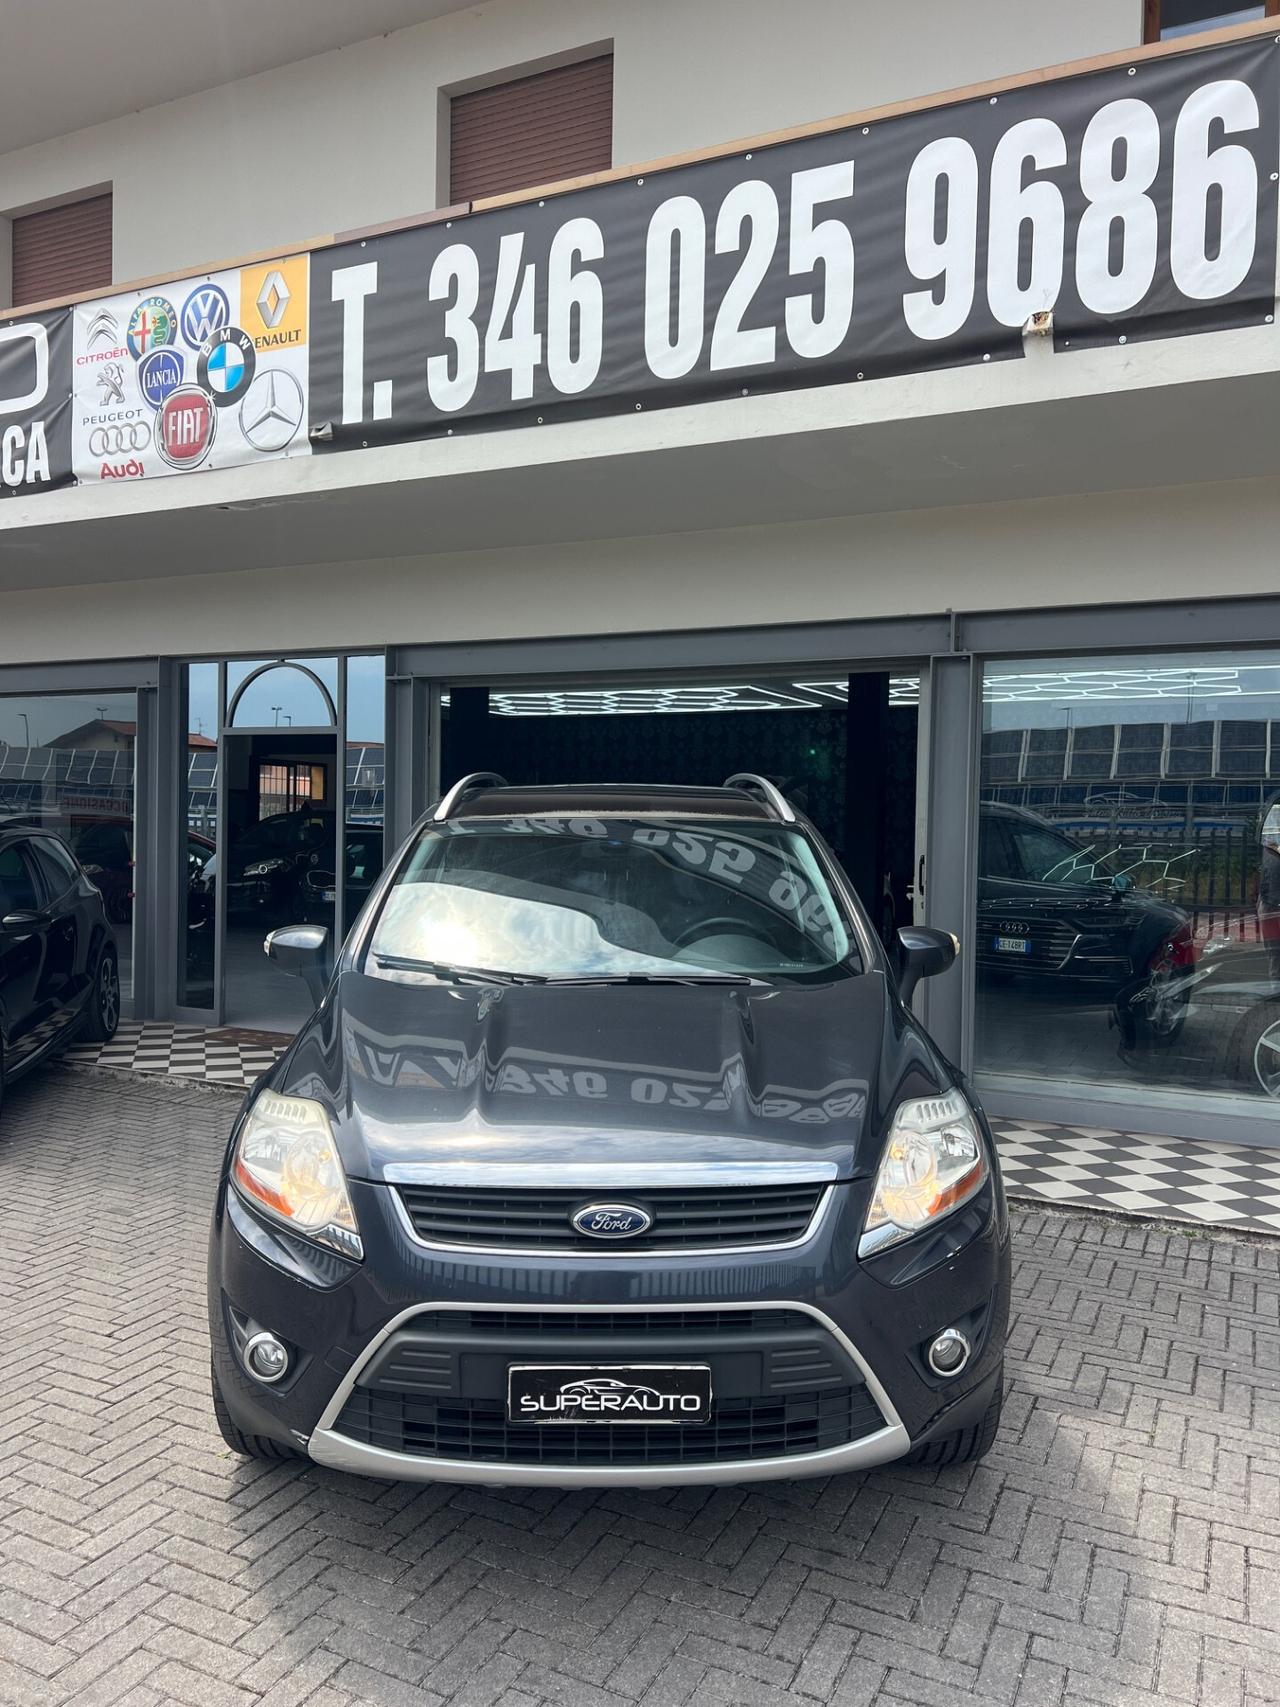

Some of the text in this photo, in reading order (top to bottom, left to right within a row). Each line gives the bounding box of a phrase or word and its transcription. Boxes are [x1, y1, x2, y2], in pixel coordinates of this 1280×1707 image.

[331, 79, 1260, 425] T. 346 025 9686
[127, 298, 177, 336] ALFA ROMEO
[201, 328, 251, 357] BMW
[253, 329, 301, 348] ENAULT
[146, 368, 177, 389] LANCIA
[82, 408, 144, 426] PEUGEOT
[167, 406, 205, 447] FIAT
[100, 458, 145, 479] Audi
[591, 1212, 632, 1231] Ford
[520, 1395, 701, 1412] SUPERAUTO
